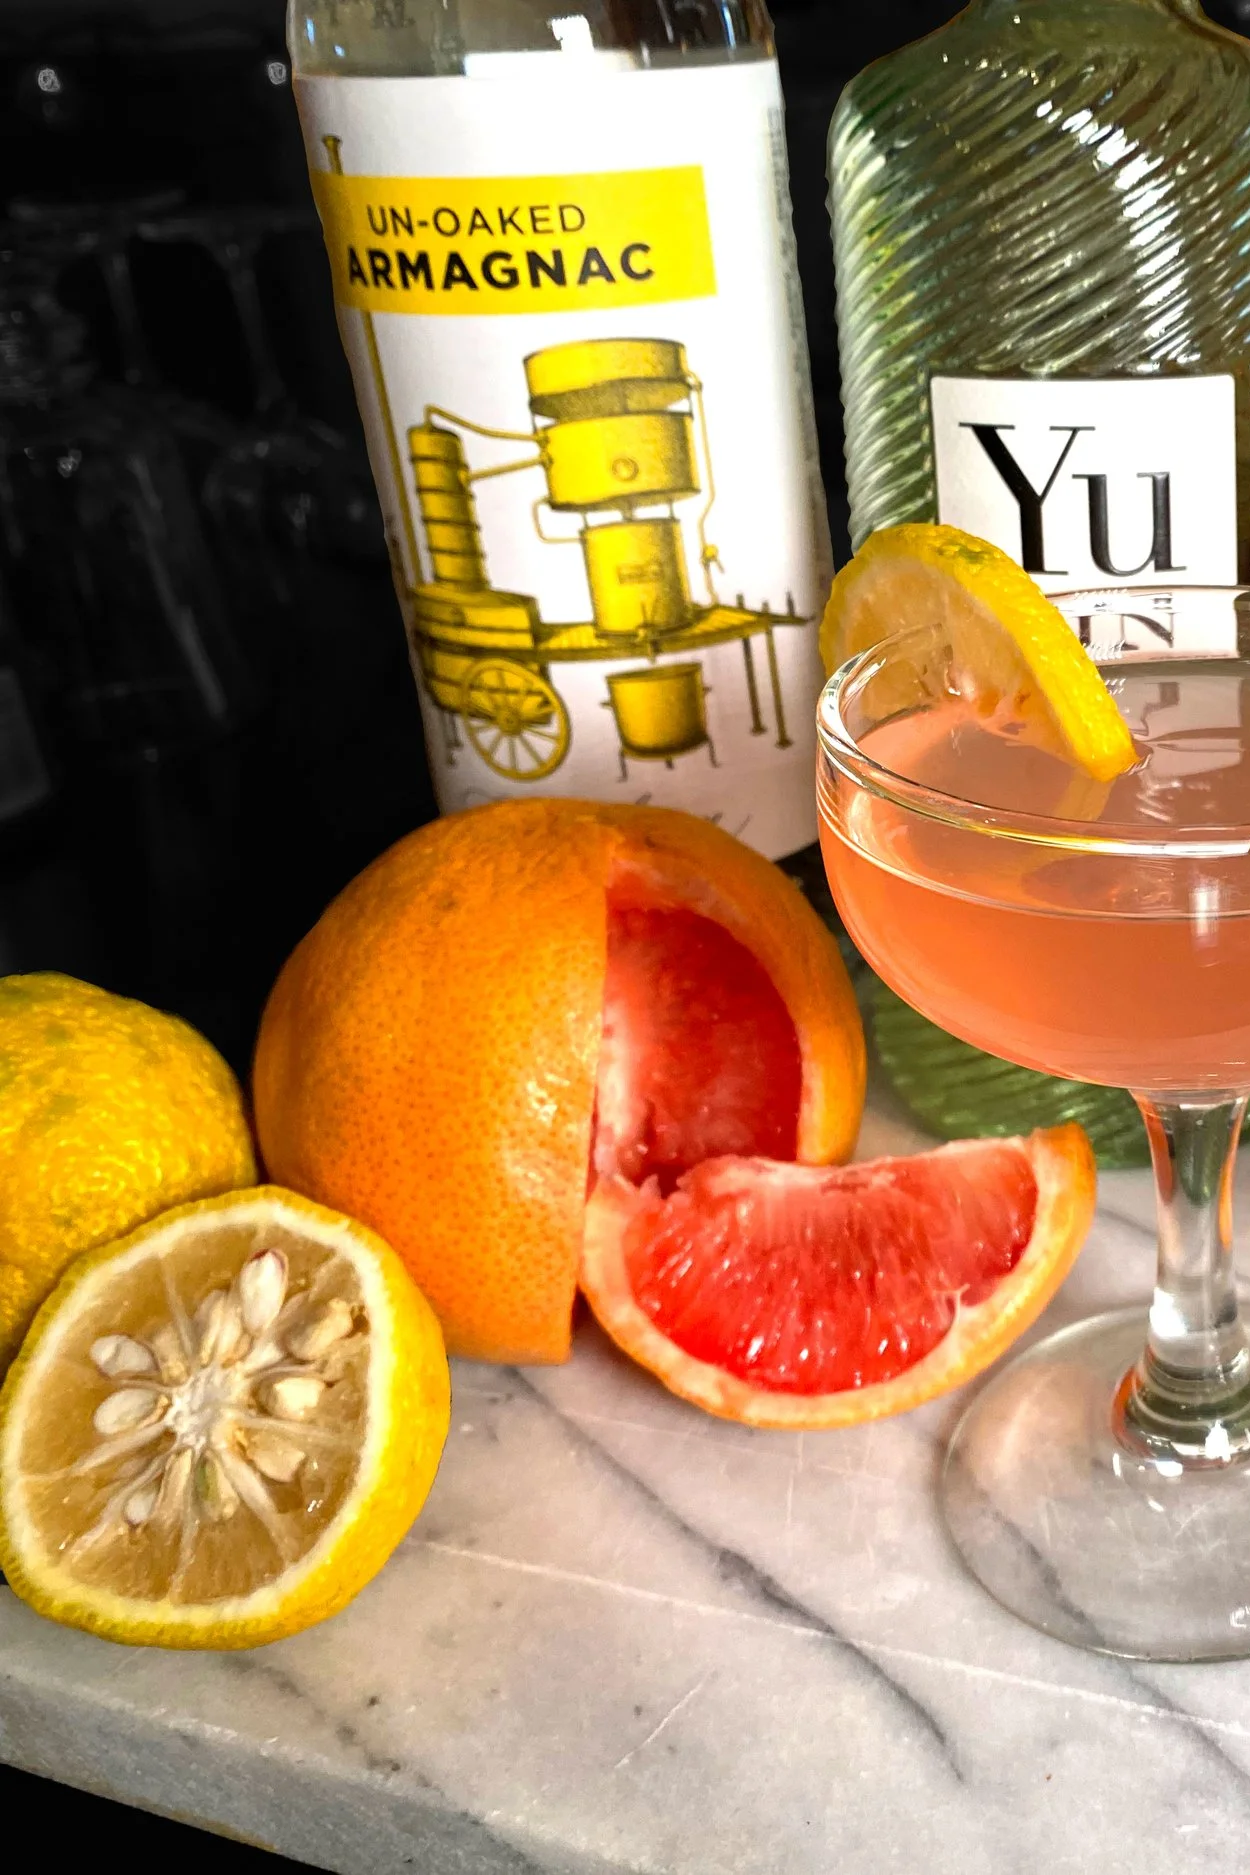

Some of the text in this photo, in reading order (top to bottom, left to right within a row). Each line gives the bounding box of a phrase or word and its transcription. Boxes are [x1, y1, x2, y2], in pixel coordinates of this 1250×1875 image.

[366, 203, 587, 238] UN-OAKED
[347, 242, 656, 293] ARMAGNAC
[958, 421, 1187, 578] Yu
